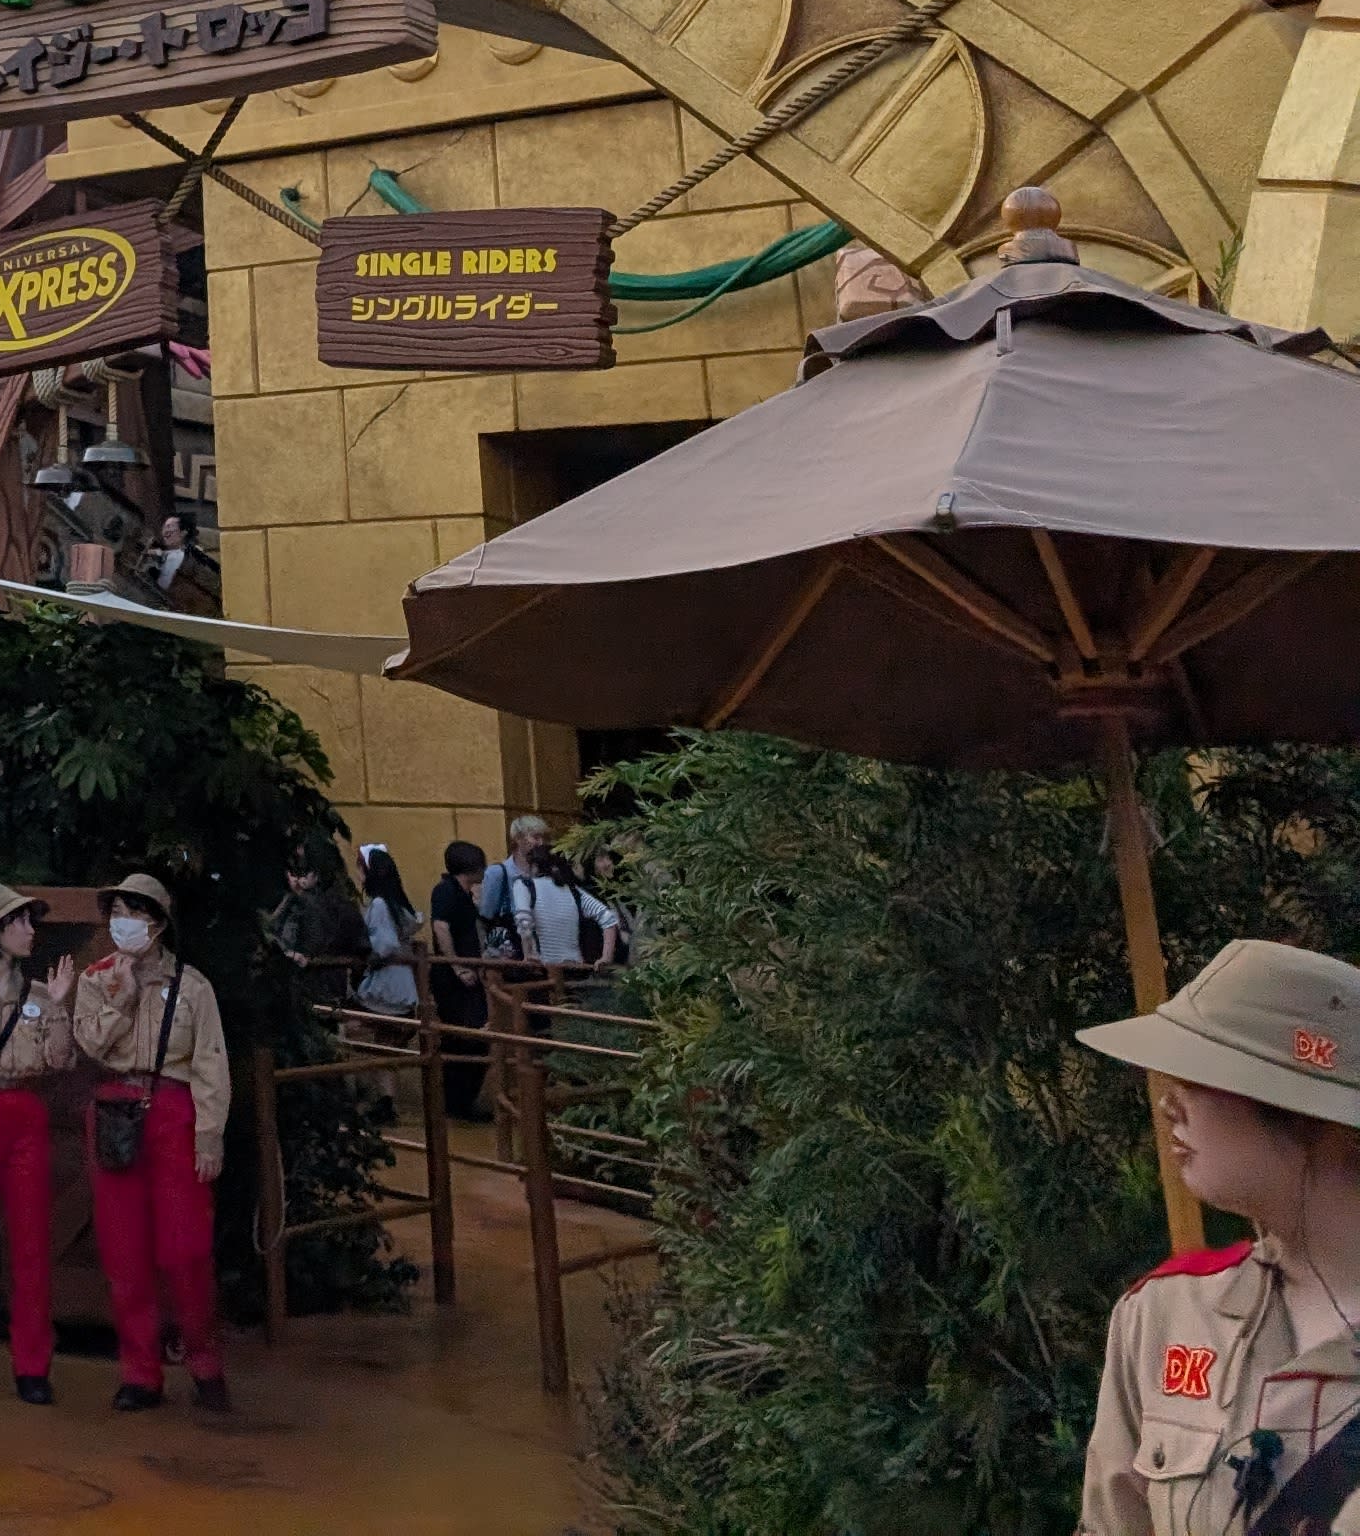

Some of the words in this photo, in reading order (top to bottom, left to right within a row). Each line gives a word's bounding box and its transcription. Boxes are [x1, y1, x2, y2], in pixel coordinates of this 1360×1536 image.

[355, 250, 452, 277] SINGLE
[462, 248, 559, 275] RIDERS
[351, 293, 559, 321] シングルライダー
[1293, 1029, 1338, 1069] DK
[1164, 1345, 1216, 1398] DK
